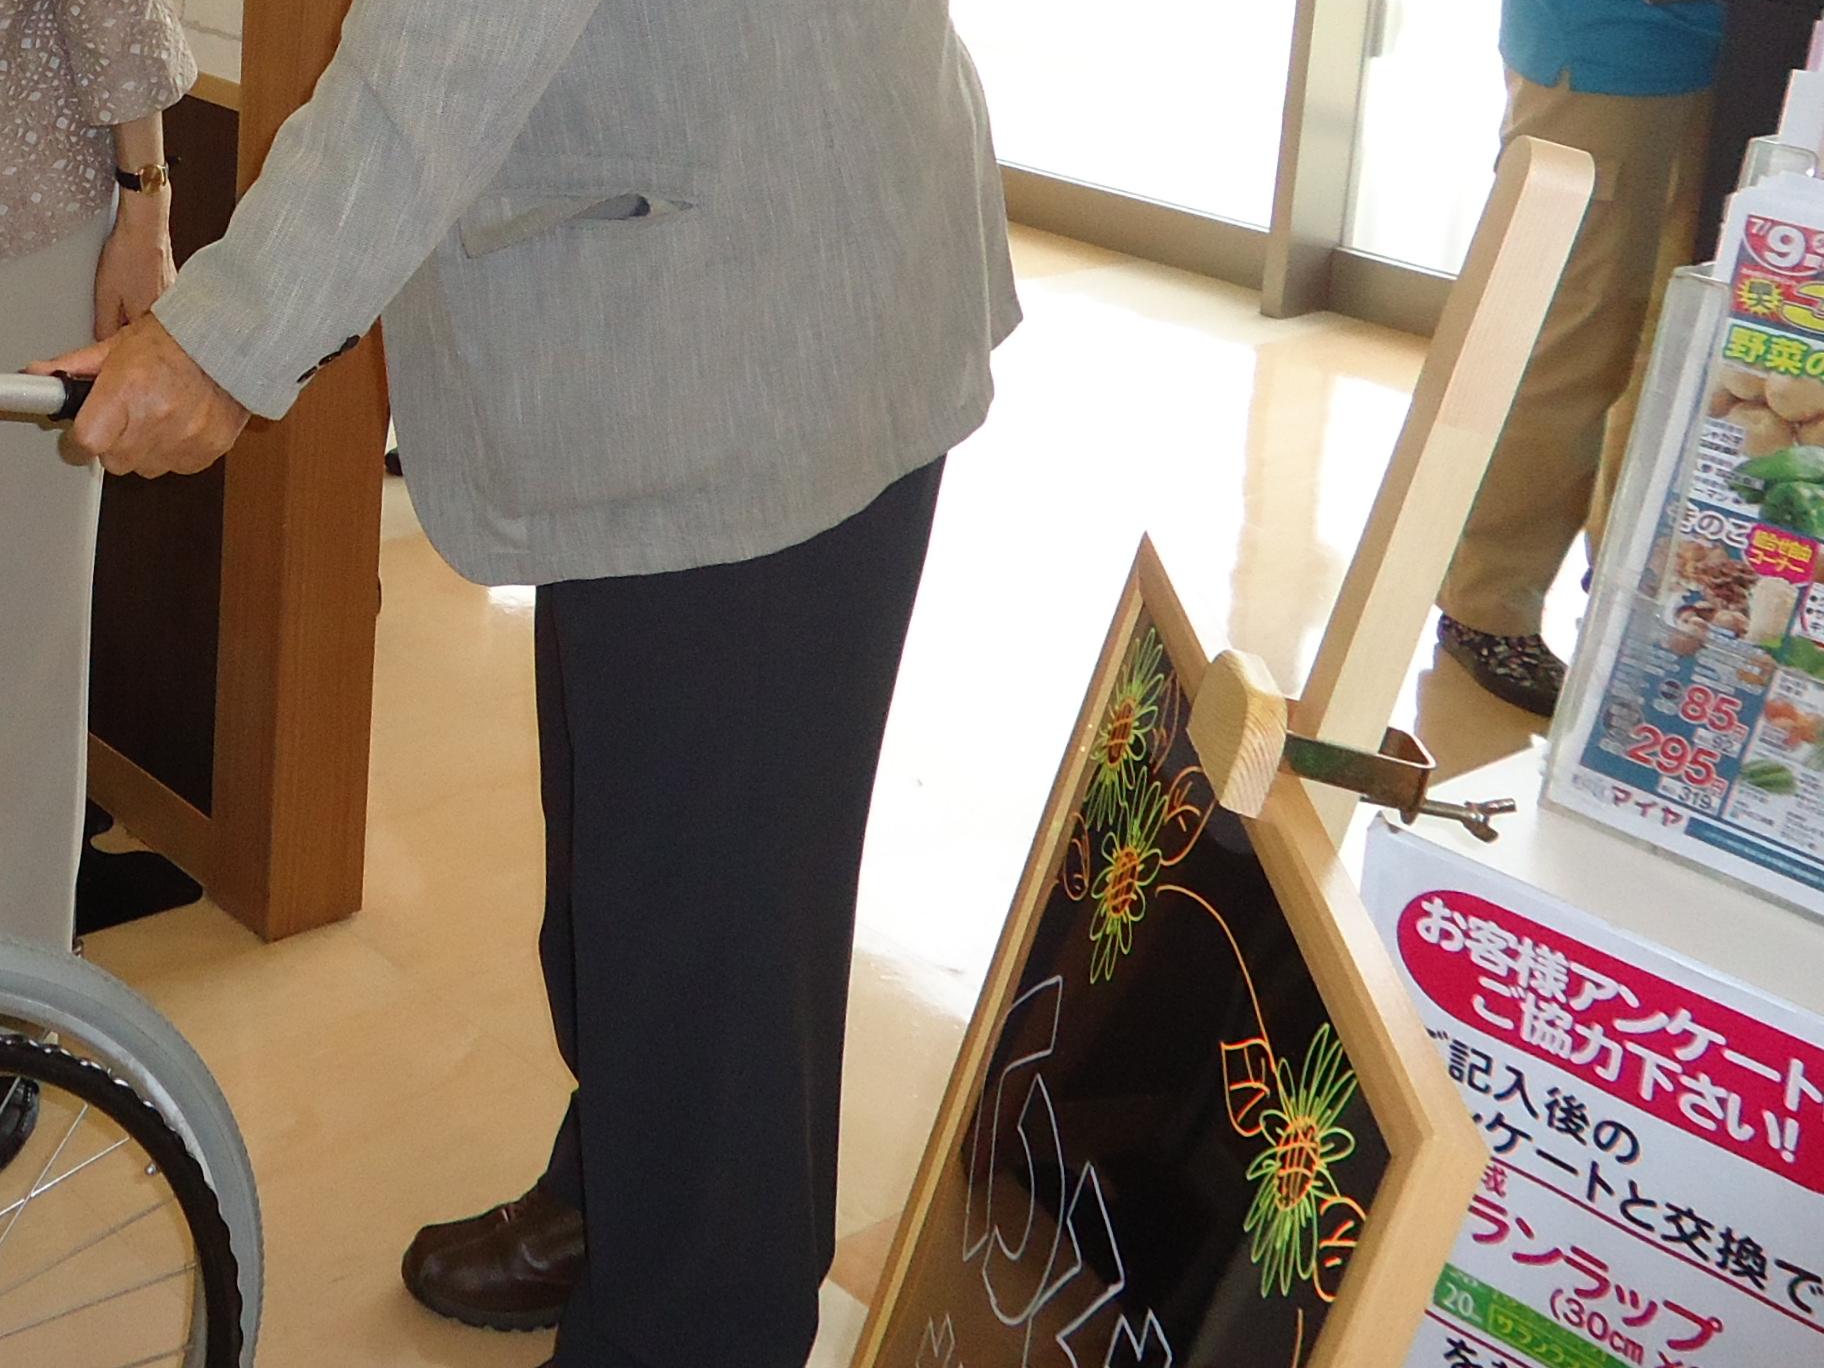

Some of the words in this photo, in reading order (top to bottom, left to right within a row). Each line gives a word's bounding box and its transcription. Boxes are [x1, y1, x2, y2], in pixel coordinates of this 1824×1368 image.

[1610, 785, 1684, 827] マイヤ
[1416, 897, 1824, 1112] お客様アンケート
[1472, 1112, 1824, 1315] ケートと交換で
